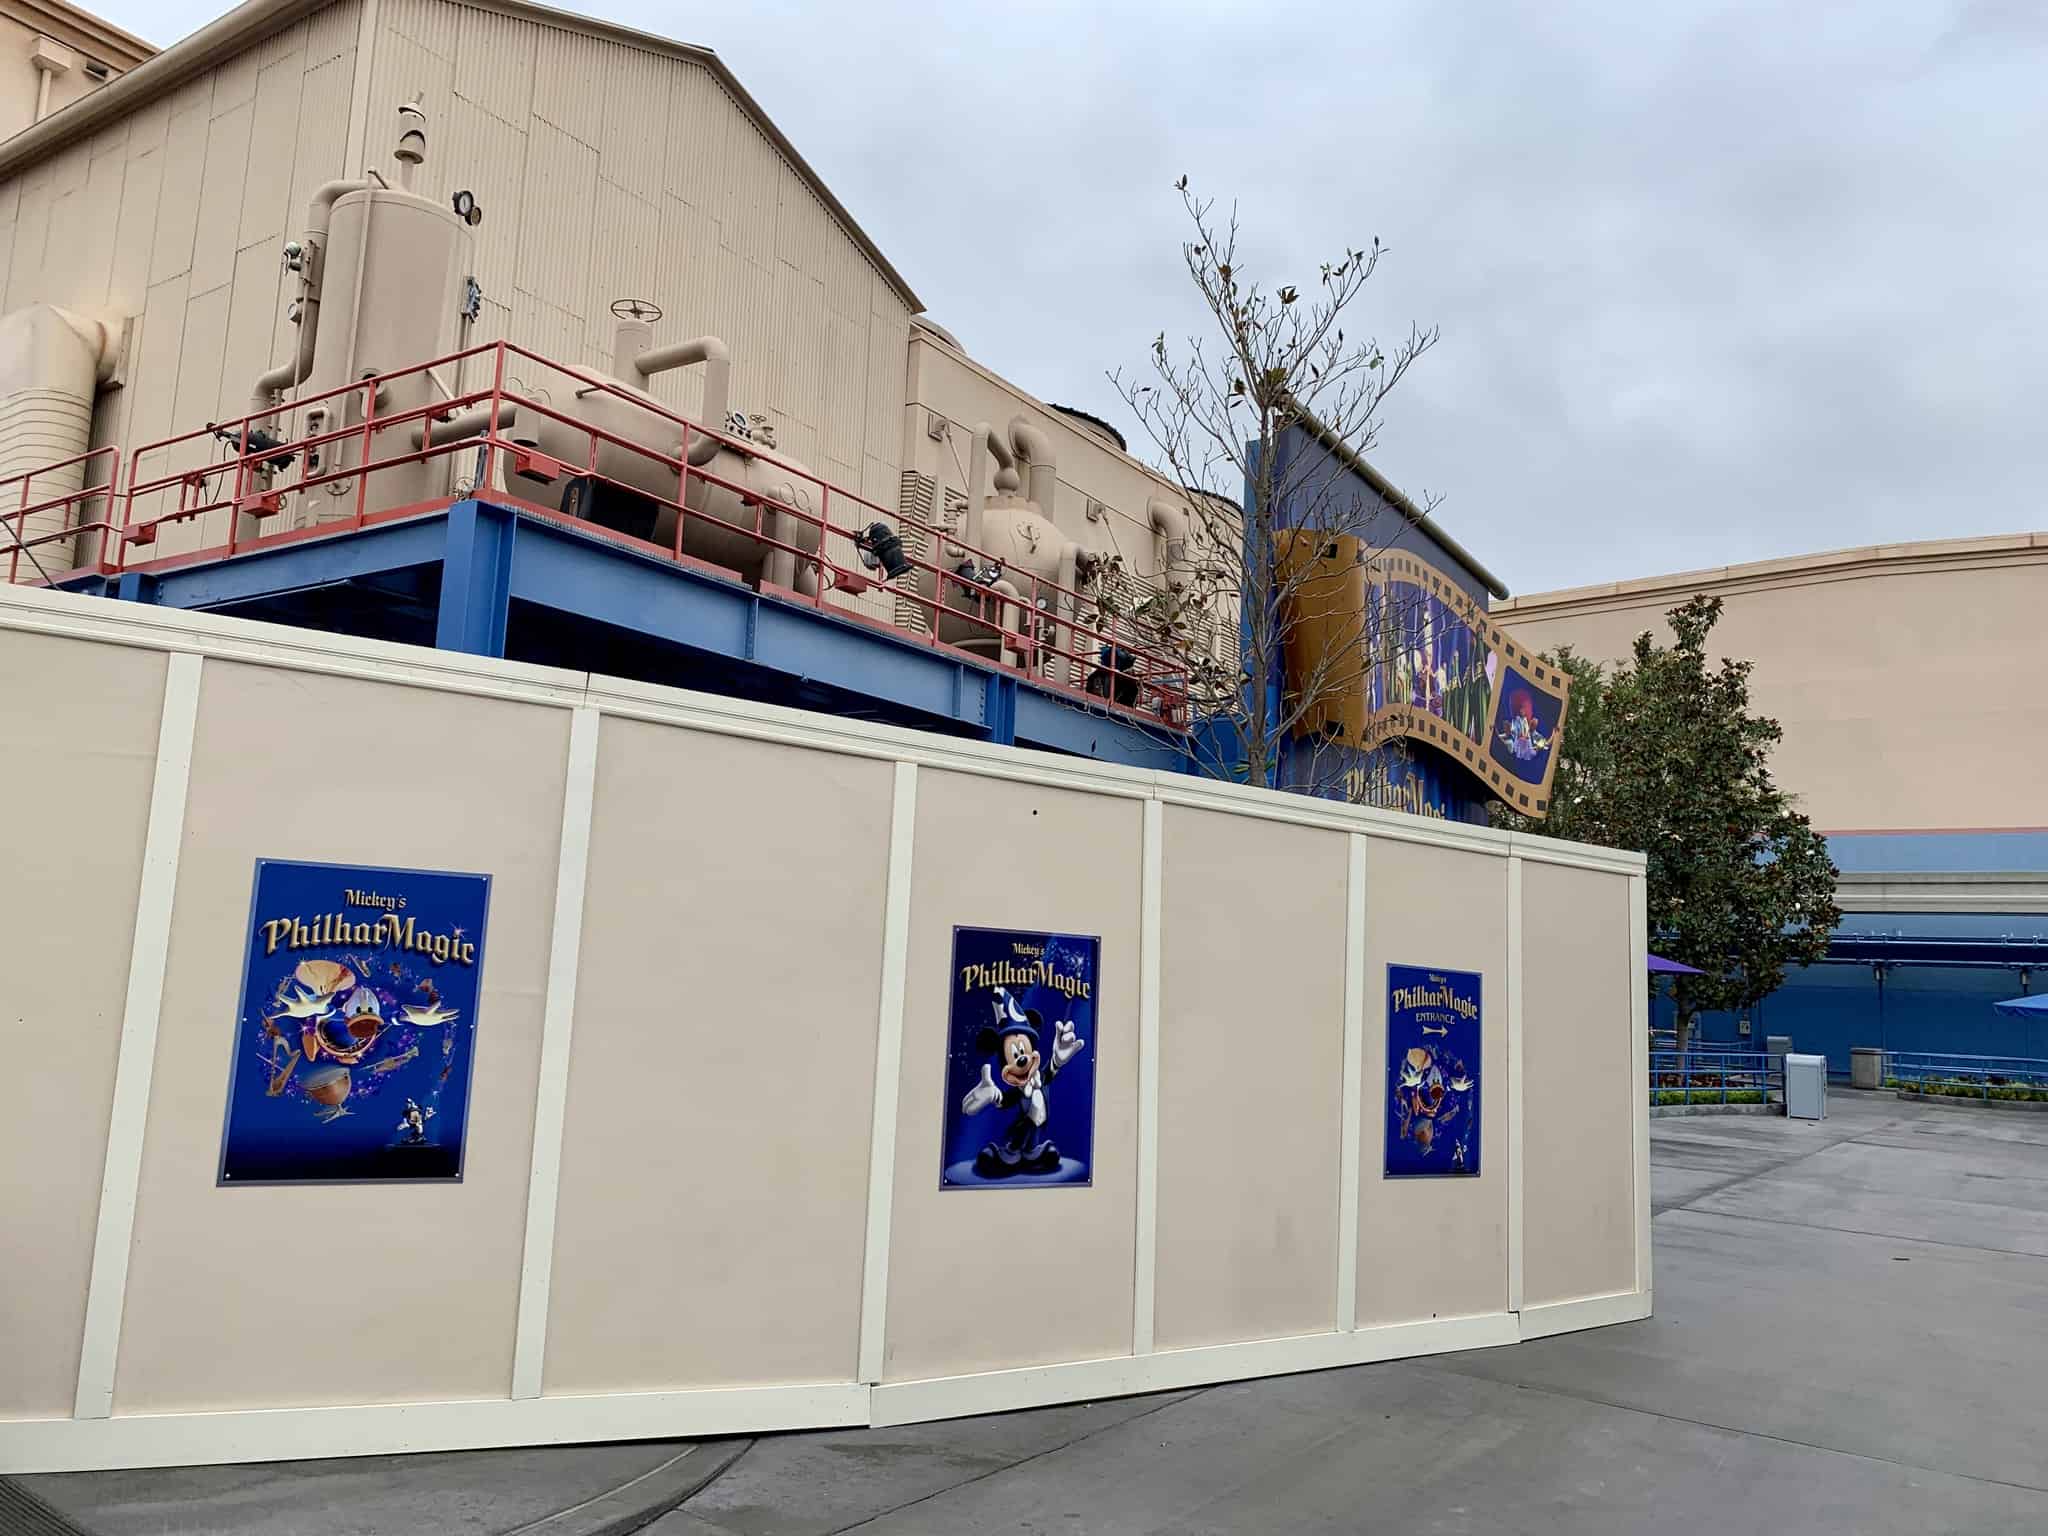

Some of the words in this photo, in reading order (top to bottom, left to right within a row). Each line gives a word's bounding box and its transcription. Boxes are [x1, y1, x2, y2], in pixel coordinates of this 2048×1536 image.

[344, 889, 408, 911] Mickey's
[258, 912, 475, 965] PhilharMagic
[960, 959, 1092, 999] PhilharMagic
[1392, 985, 1479, 1020] PhilharMagic
[1415, 1011, 1456, 1025] ENTRANCE
